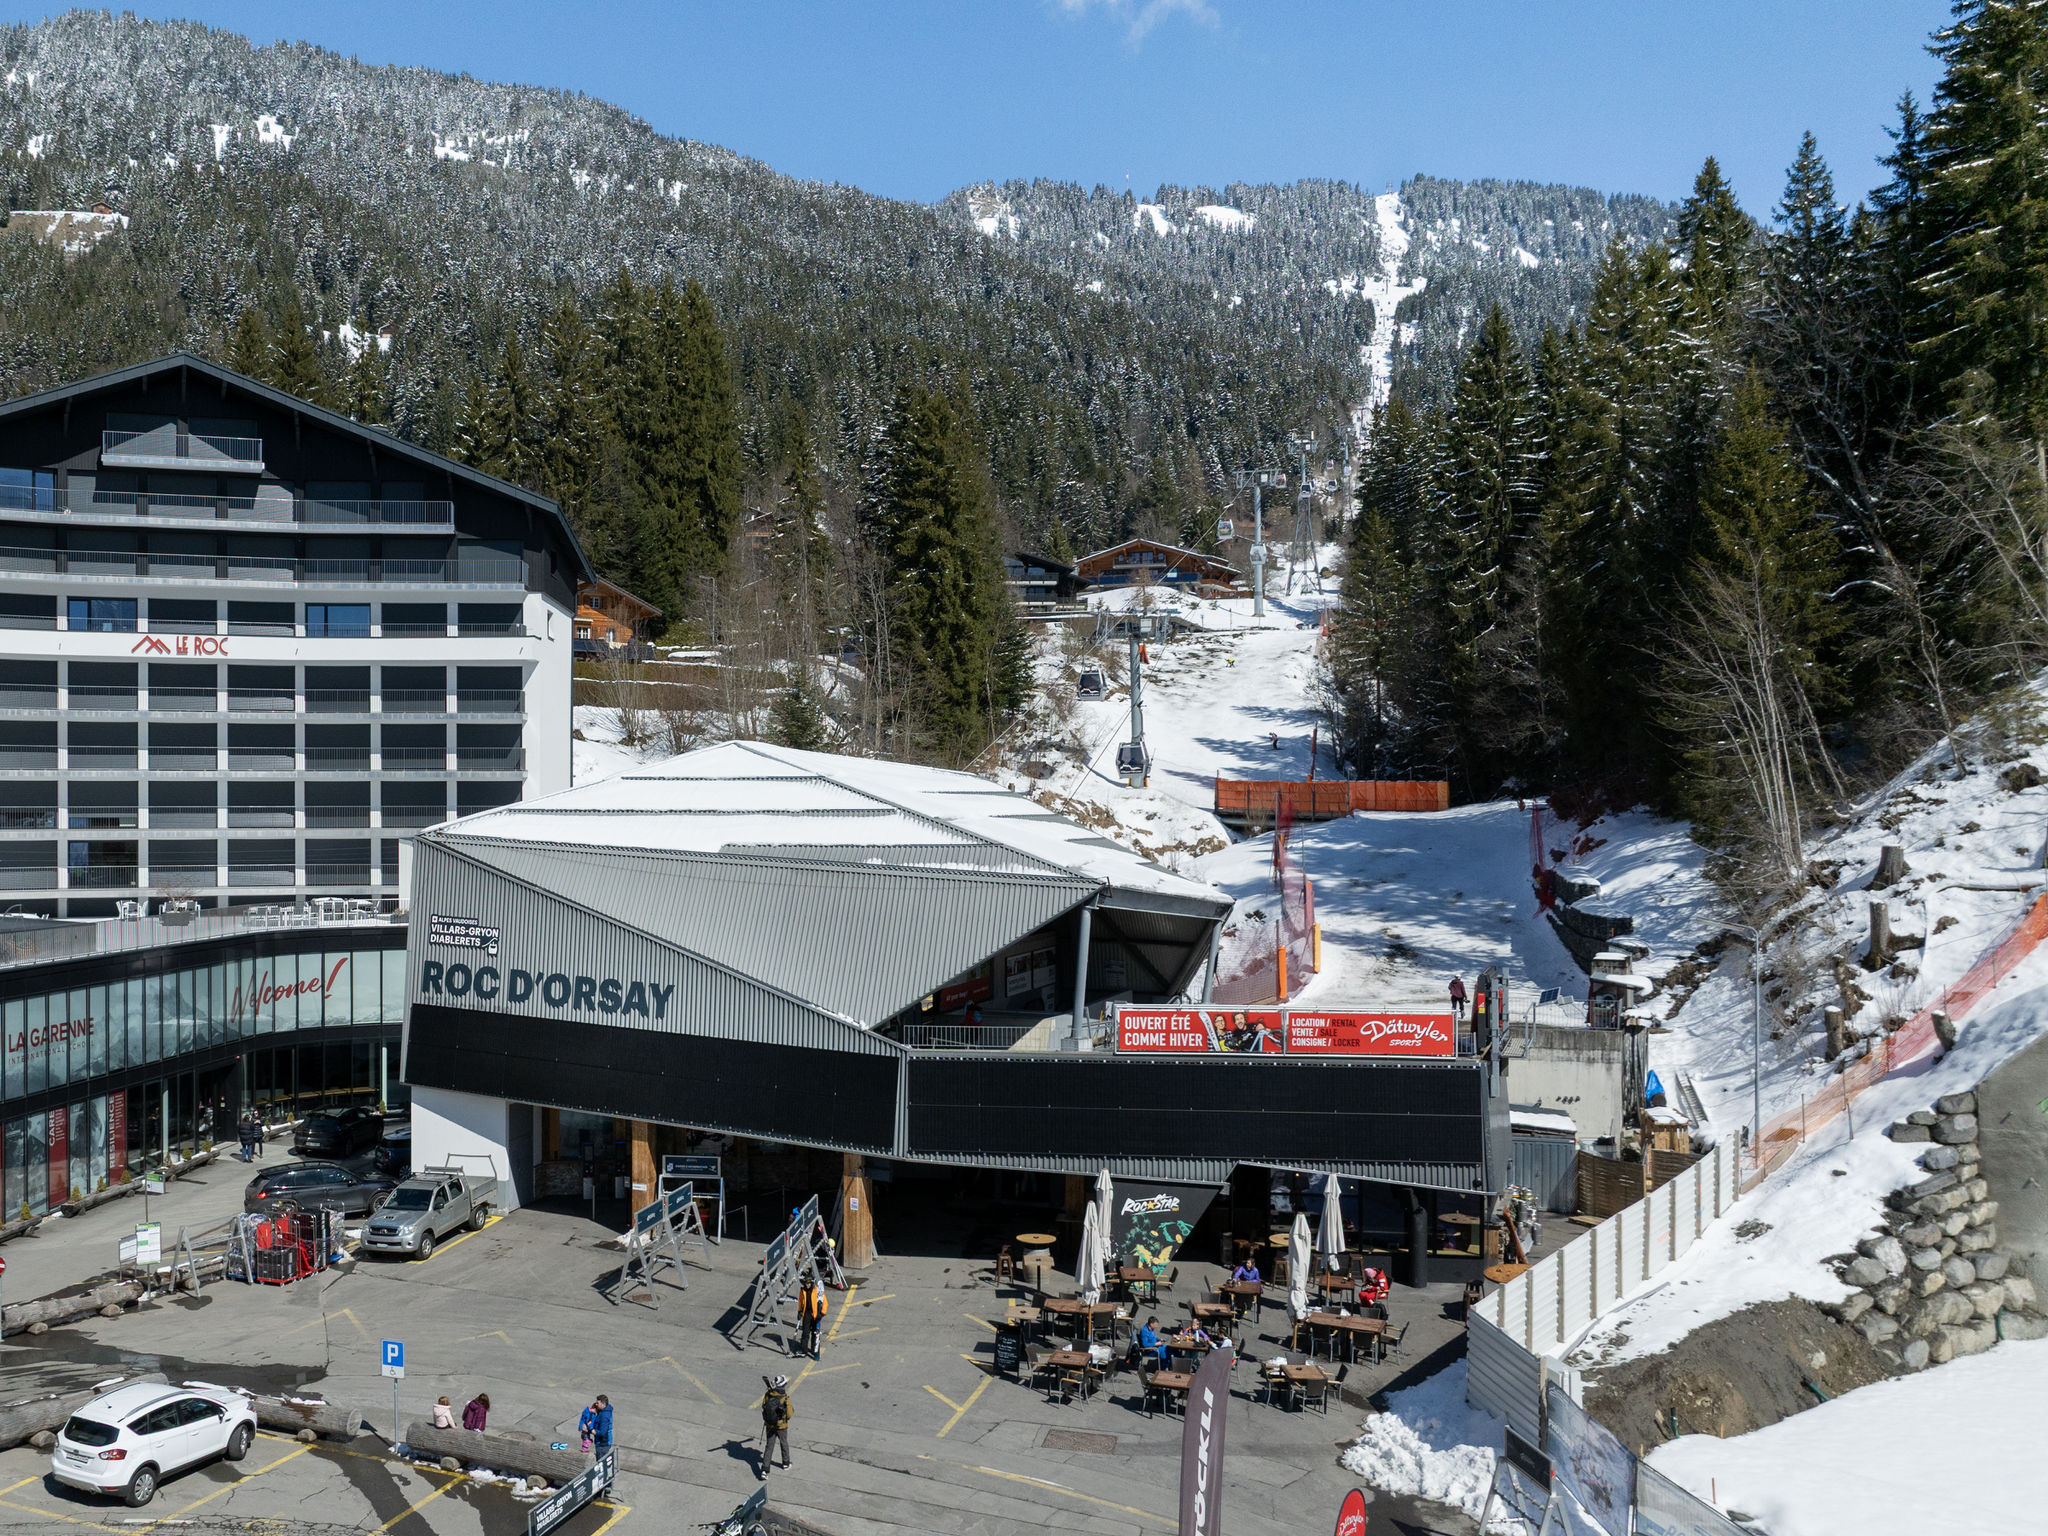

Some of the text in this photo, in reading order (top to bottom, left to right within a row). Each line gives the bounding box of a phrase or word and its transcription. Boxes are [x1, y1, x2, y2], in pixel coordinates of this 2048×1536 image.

[176, 636, 229, 656] LE ROC
[431, 923, 499, 938] VILLARS-GRYON
[430, 934, 481, 947] DIABLERETS
[231, 957, 349, 1024] Welcome!
[421, 960, 675, 1020] ROC D'ORSAY
[1124, 1013, 1191, 1031] OUVERT ÉTÉ
[1291, 1018, 1325, 1028] LOCATION
[1331, 1018, 1357, 1028] RENTAL
[8, 1017, 94, 1053] LA GARENNE
[1291, 1028, 1314, 1037] VENTE
[1320, 1028, 1338, 1037] SALE
[1360, 1019, 1449, 1043] Dätwyler
[1124, 1032, 1203, 1047] COMME HIVER
[1291, 1038, 1327, 1047] CONSIGNE
[1333, 1038, 1361, 1047] LOCKER
[1389, 1039, 1422, 1047] SPORTS
[387, 1343, 399, 1363] P
